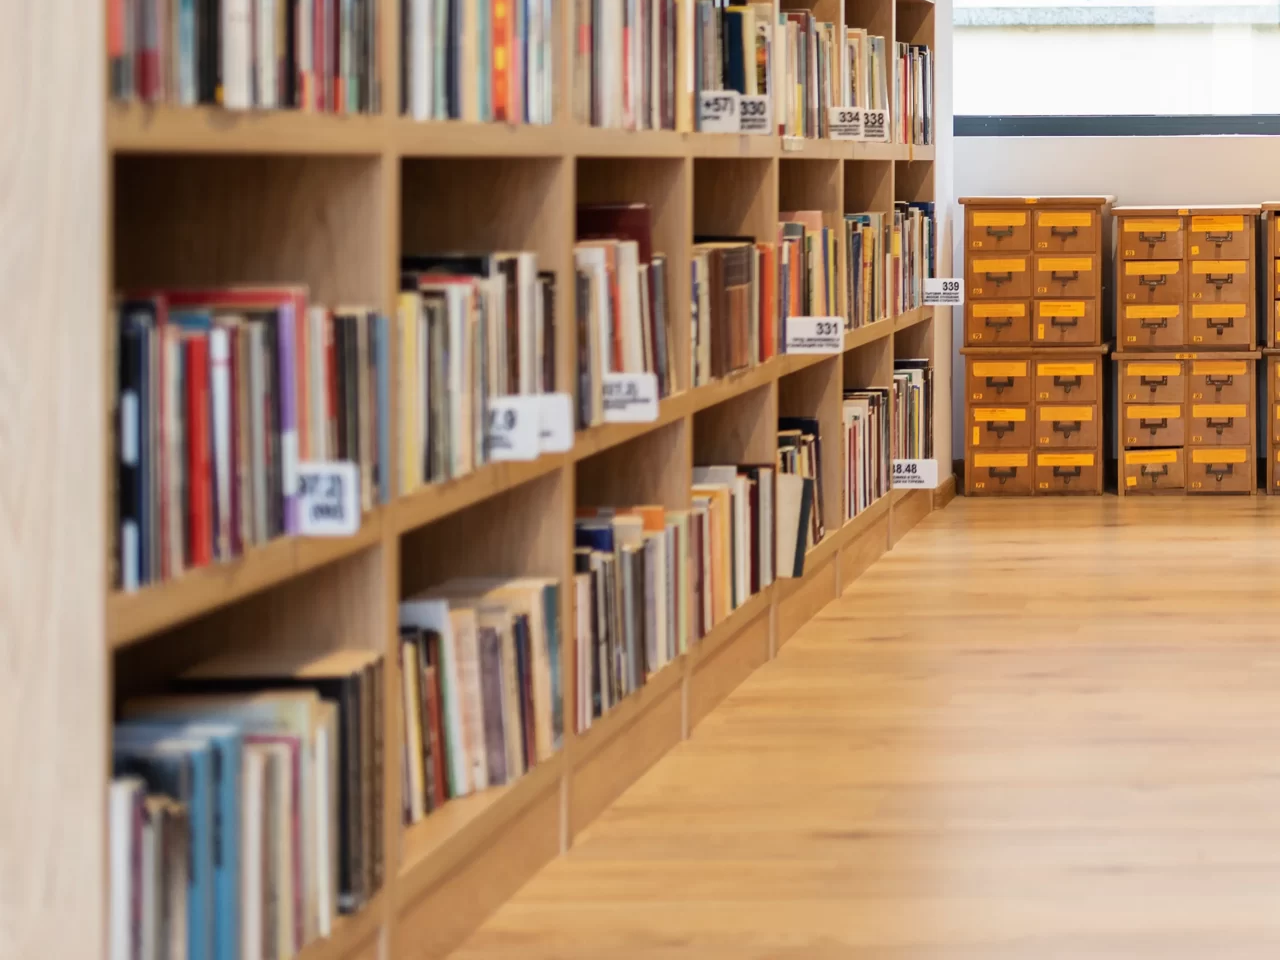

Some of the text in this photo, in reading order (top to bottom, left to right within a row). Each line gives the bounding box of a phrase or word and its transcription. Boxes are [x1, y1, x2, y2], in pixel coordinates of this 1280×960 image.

[740, 101, 766, 116] 330
[839, 111, 860, 123] 334
[864, 113, 884, 125] 338
[942, 281, 960, 291] 339
[816, 322, 838, 334] 331
